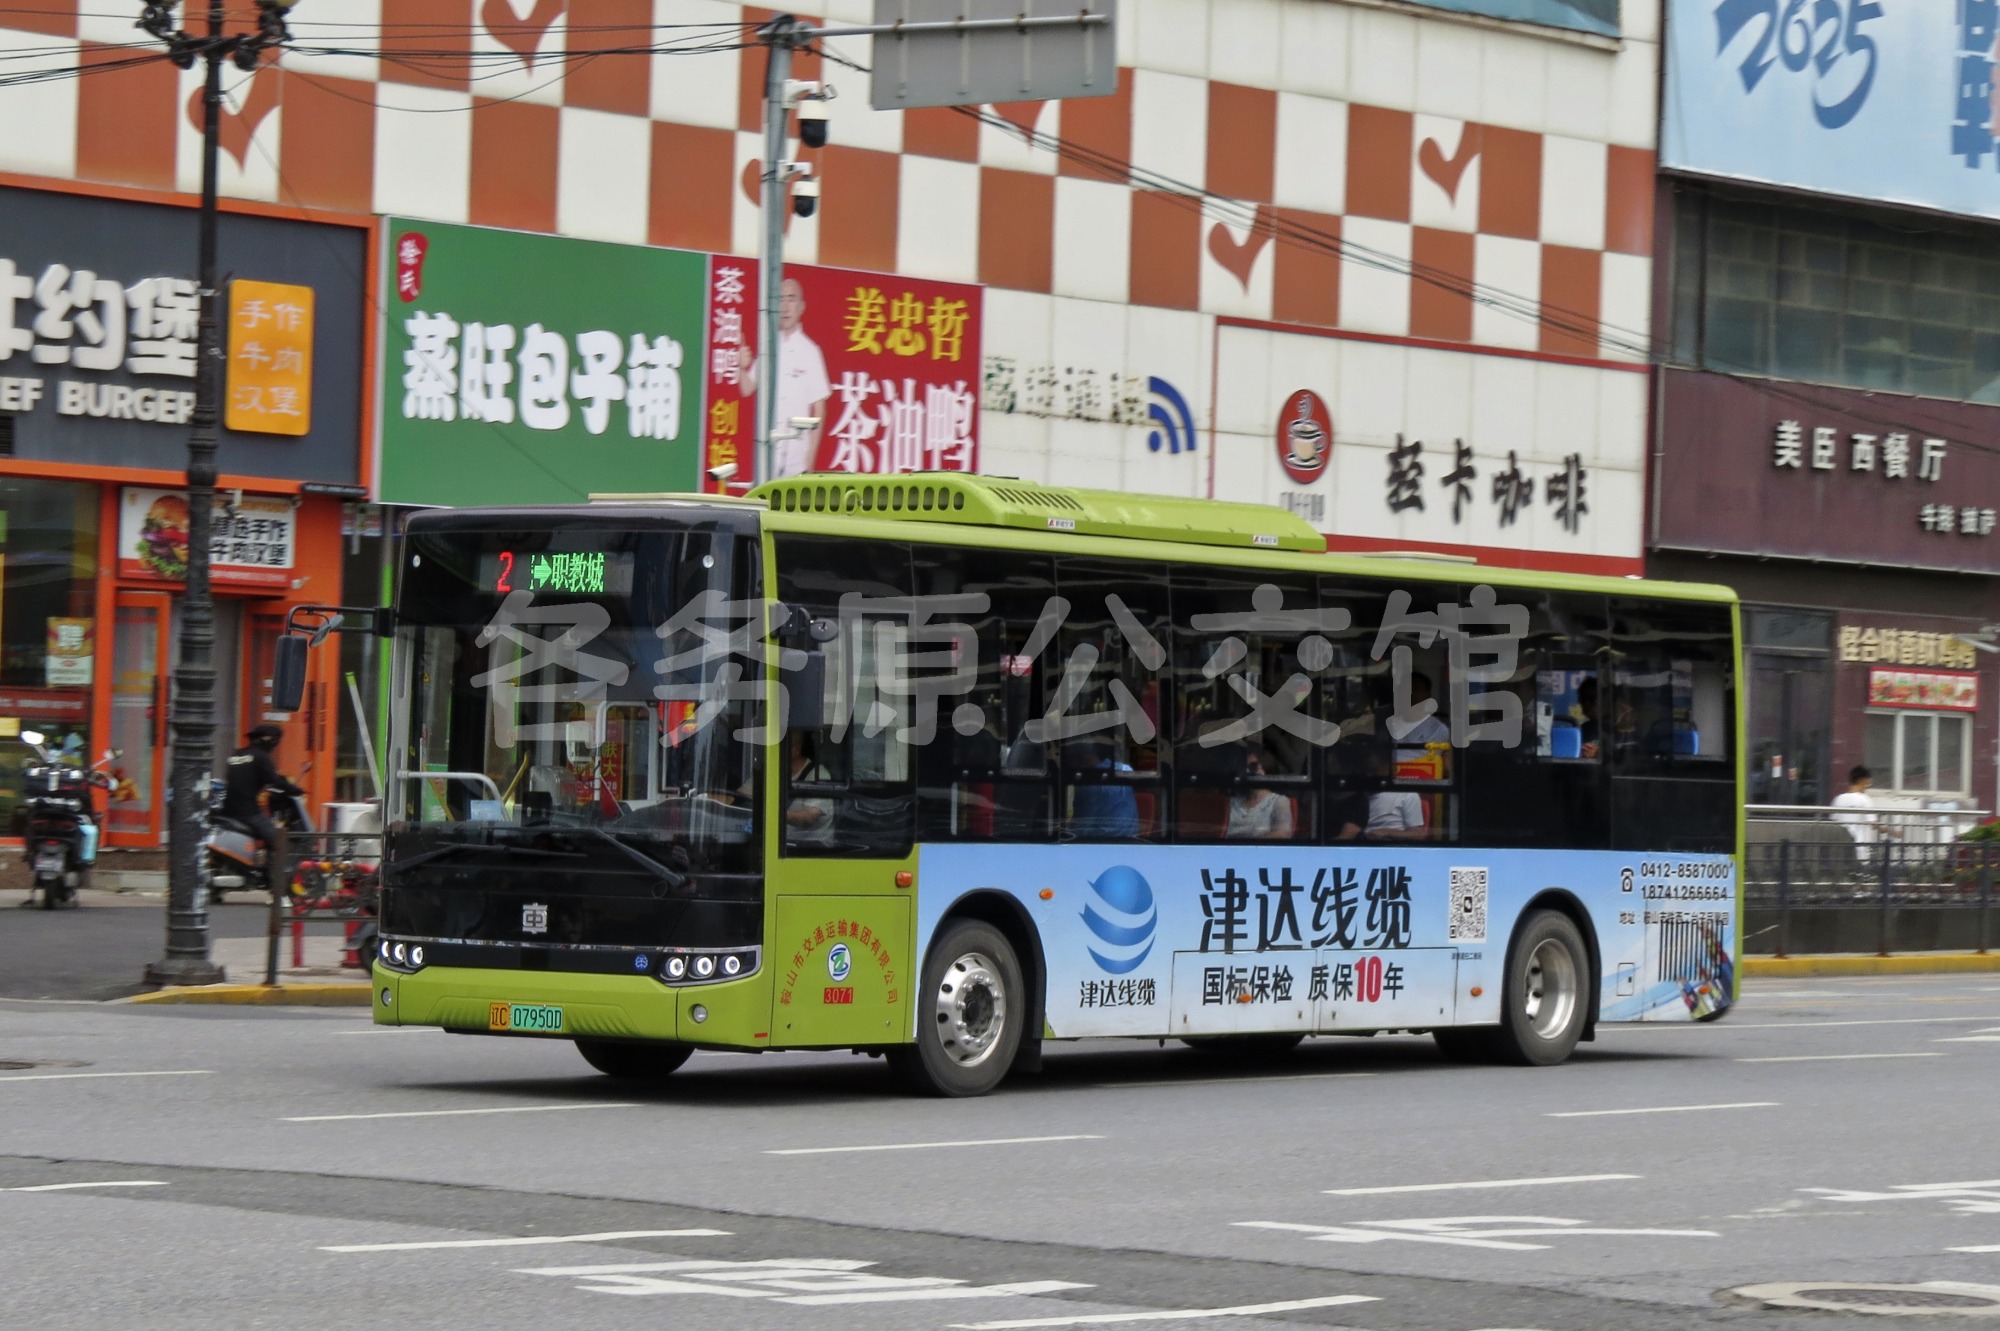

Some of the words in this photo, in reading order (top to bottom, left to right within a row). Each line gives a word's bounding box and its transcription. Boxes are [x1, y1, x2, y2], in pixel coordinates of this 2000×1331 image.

[237, 299, 306, 333] 手作
[711, 266, 746, 386] 茶油鸭
[842, 286, 971, 363] 姜忠哲
[237, 341, 304, 376] 牛肉
[402, 310, 684, 441] 蒸旺包子铺
[57, 380, 197, 425] BURGER
[234, 385, 302, 417] 汉堡
[828, 371, 977, 475] 茶油鸭
[497, 551, 514, 593] 2
[550, 552, 606, 593] 职教城
[1199, 866, 1413, 954] 津达线缆
[780, 918, 898, 1006] 鞍山市交通运输集团有限公司
[824, 988, 853, 1004] 3071
[1078, 978, 1157, 1009] 津达线缆
